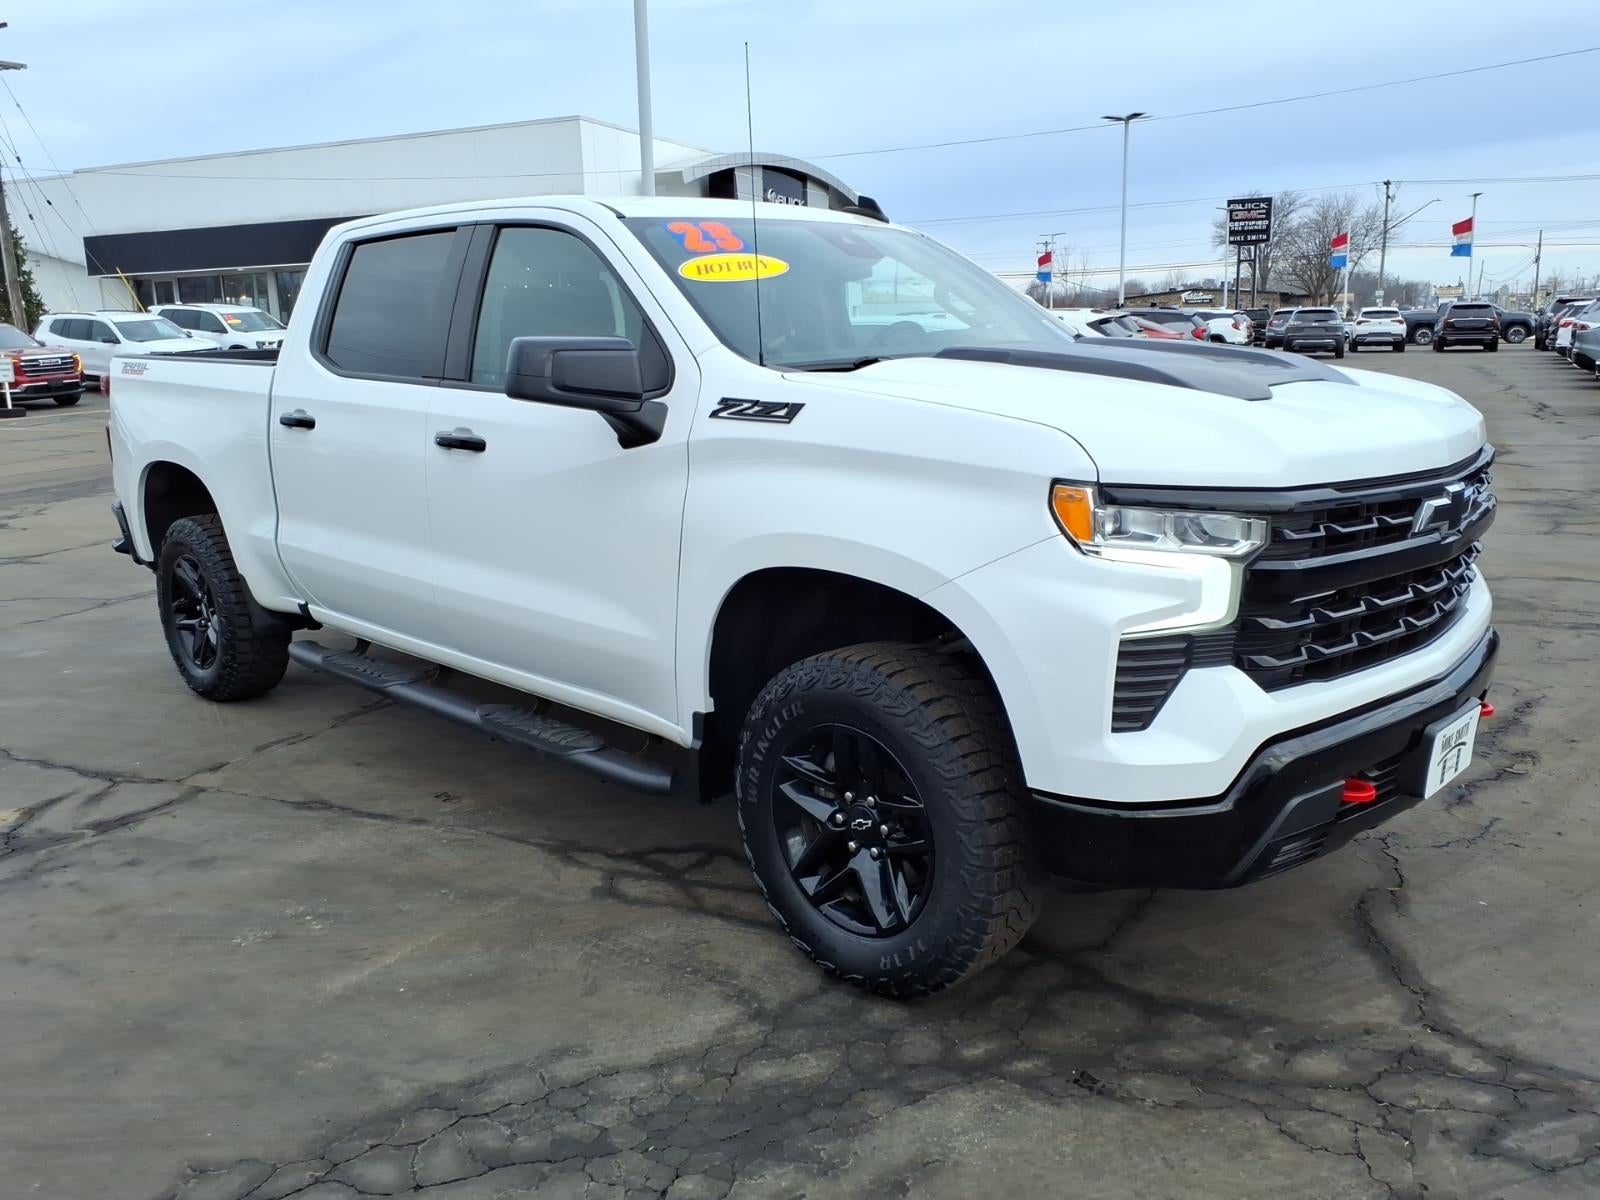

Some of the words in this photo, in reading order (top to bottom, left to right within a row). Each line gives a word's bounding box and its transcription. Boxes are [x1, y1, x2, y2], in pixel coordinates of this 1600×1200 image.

[1232, 210, 1266, 219] GMC
[667, 221, 744, 252] 23
[695, 261, 732, 275] HOT
[738, 259, 770, 271] BUY
